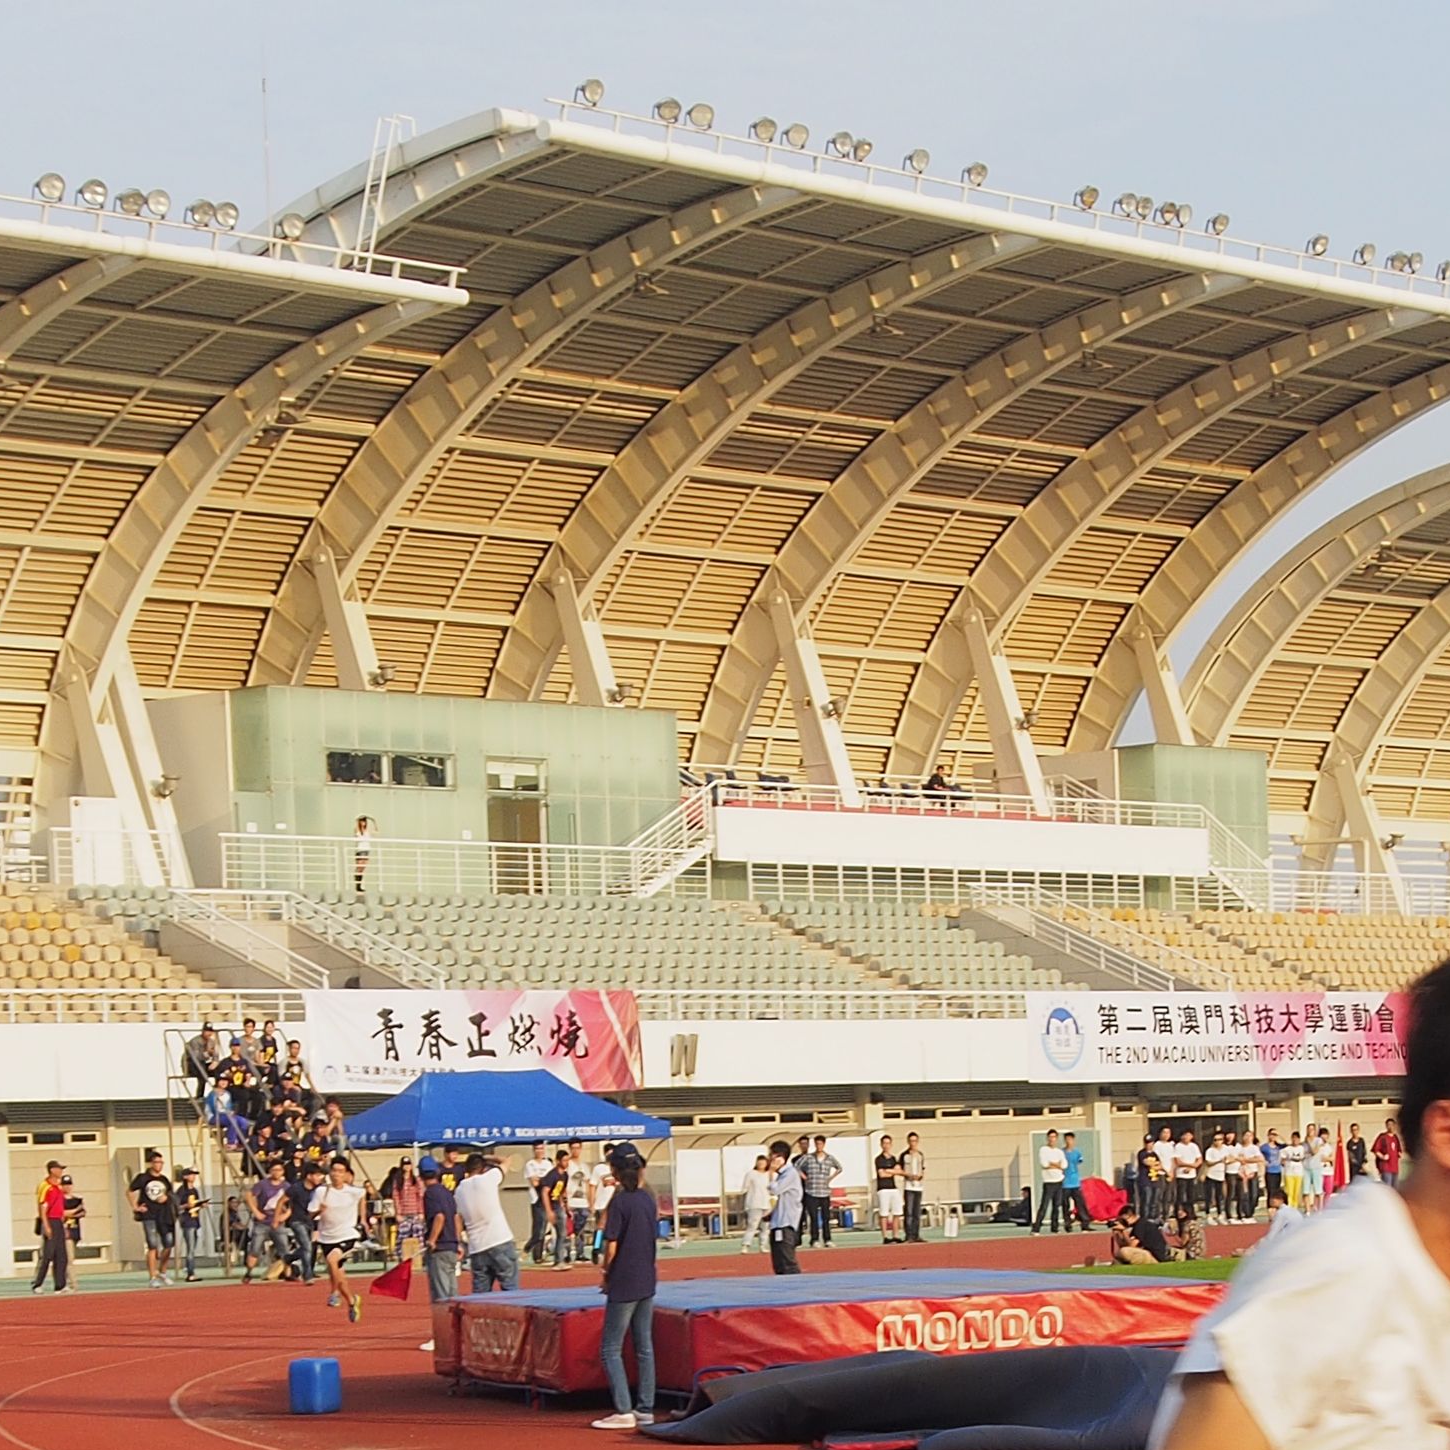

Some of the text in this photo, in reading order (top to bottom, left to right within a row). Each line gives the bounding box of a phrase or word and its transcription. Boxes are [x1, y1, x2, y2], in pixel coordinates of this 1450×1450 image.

[371, 1008, 589, 1062] 青春正燃燒
[1098, 1046, 1122, 1064] THE
[1126, 1046, 1149, 1064] 2ND
[1153, 1046, 1197, 1063] MACAU
[1200, 1045, 1269, 1063] UNIVERSITY
[1271, 1044, 1285, 1061] OF
[1288, 1044, 1338, 1061] SCIENCE
[1340, 1043, 1363, 1060] AND
[876, 1305, 1064, 1353] MONDO
